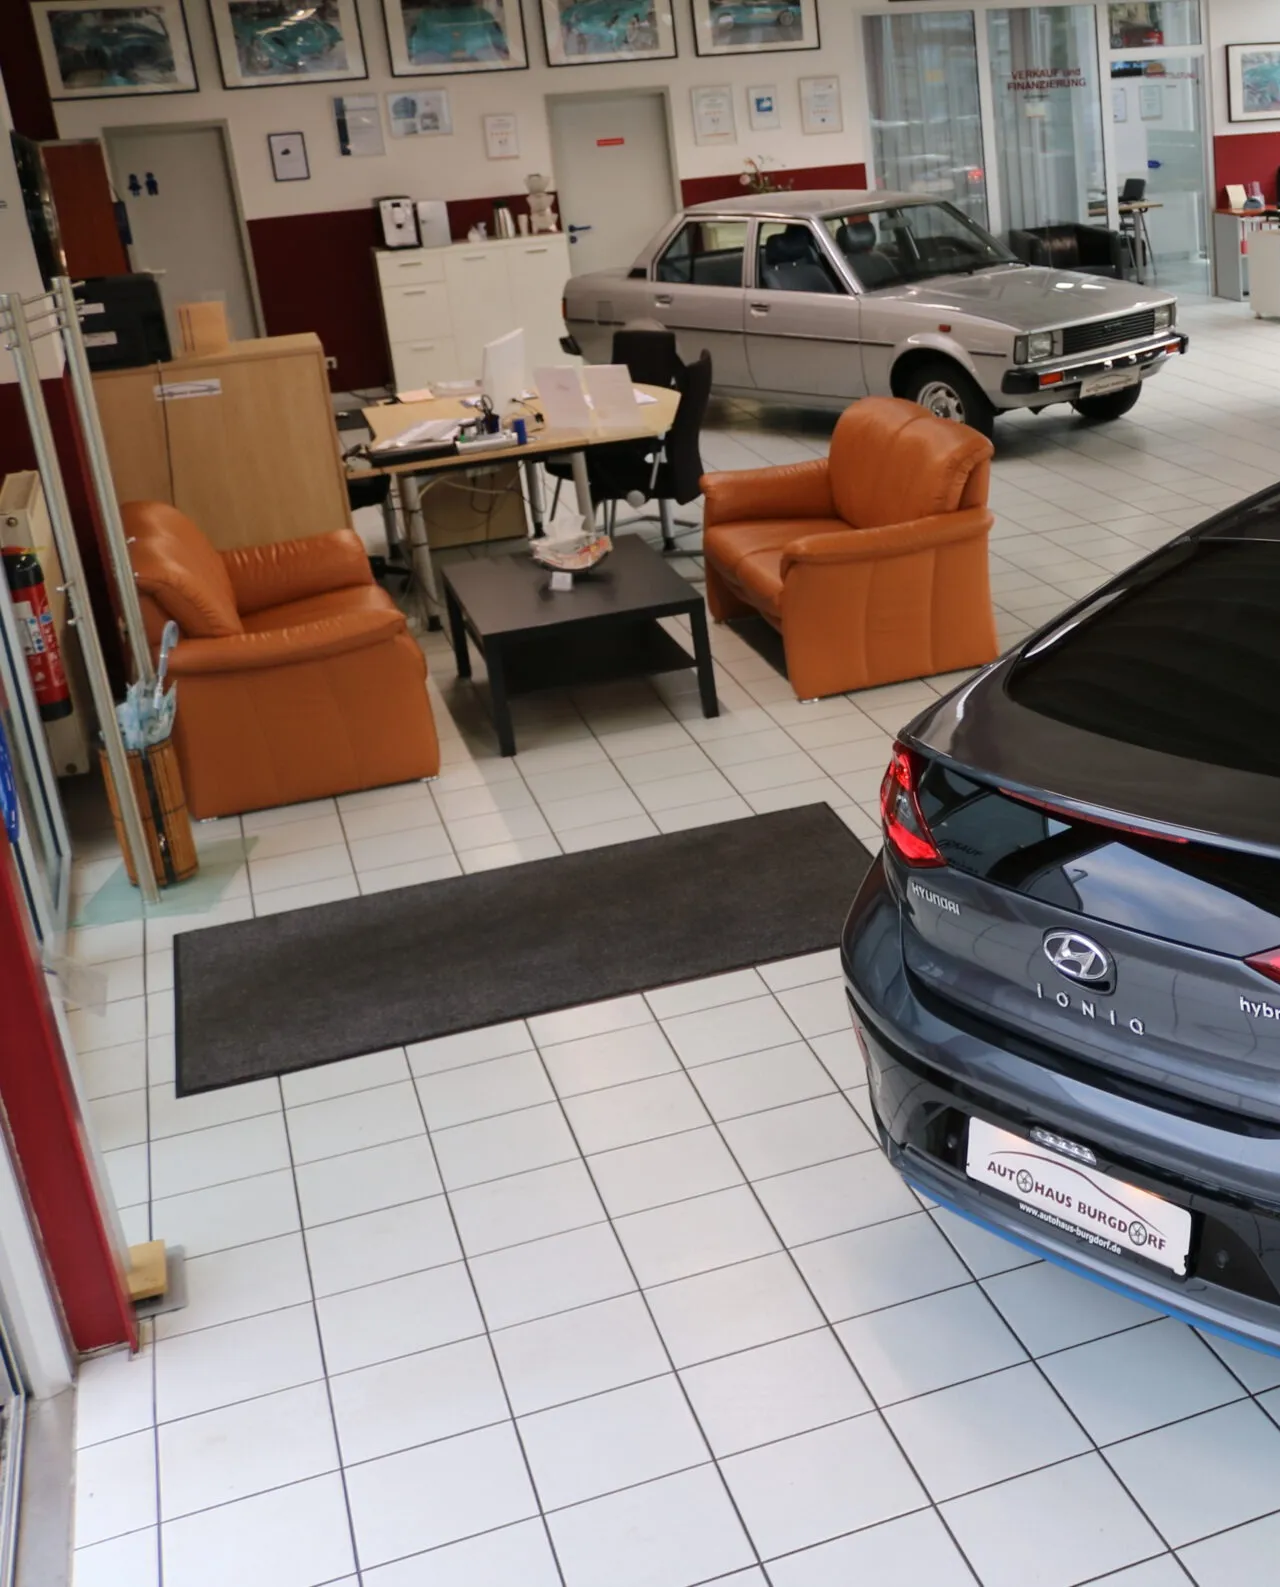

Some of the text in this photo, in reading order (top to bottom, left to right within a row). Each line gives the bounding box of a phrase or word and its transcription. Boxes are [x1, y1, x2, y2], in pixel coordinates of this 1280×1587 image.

[1007, 77, 1086, 91] FINANZIERUNG
[1011, 68, 1057, 81] VERKAUF
[911, 882, 960, 916] HYUNDAI
[1037, 983, 1144, 1035] IONIQ
[987, 1160, 1167, 1251] AUTOHAUS BURGDORF
[1019, 1202, 1122, 1255] www.autohaus-burgdorf.de
